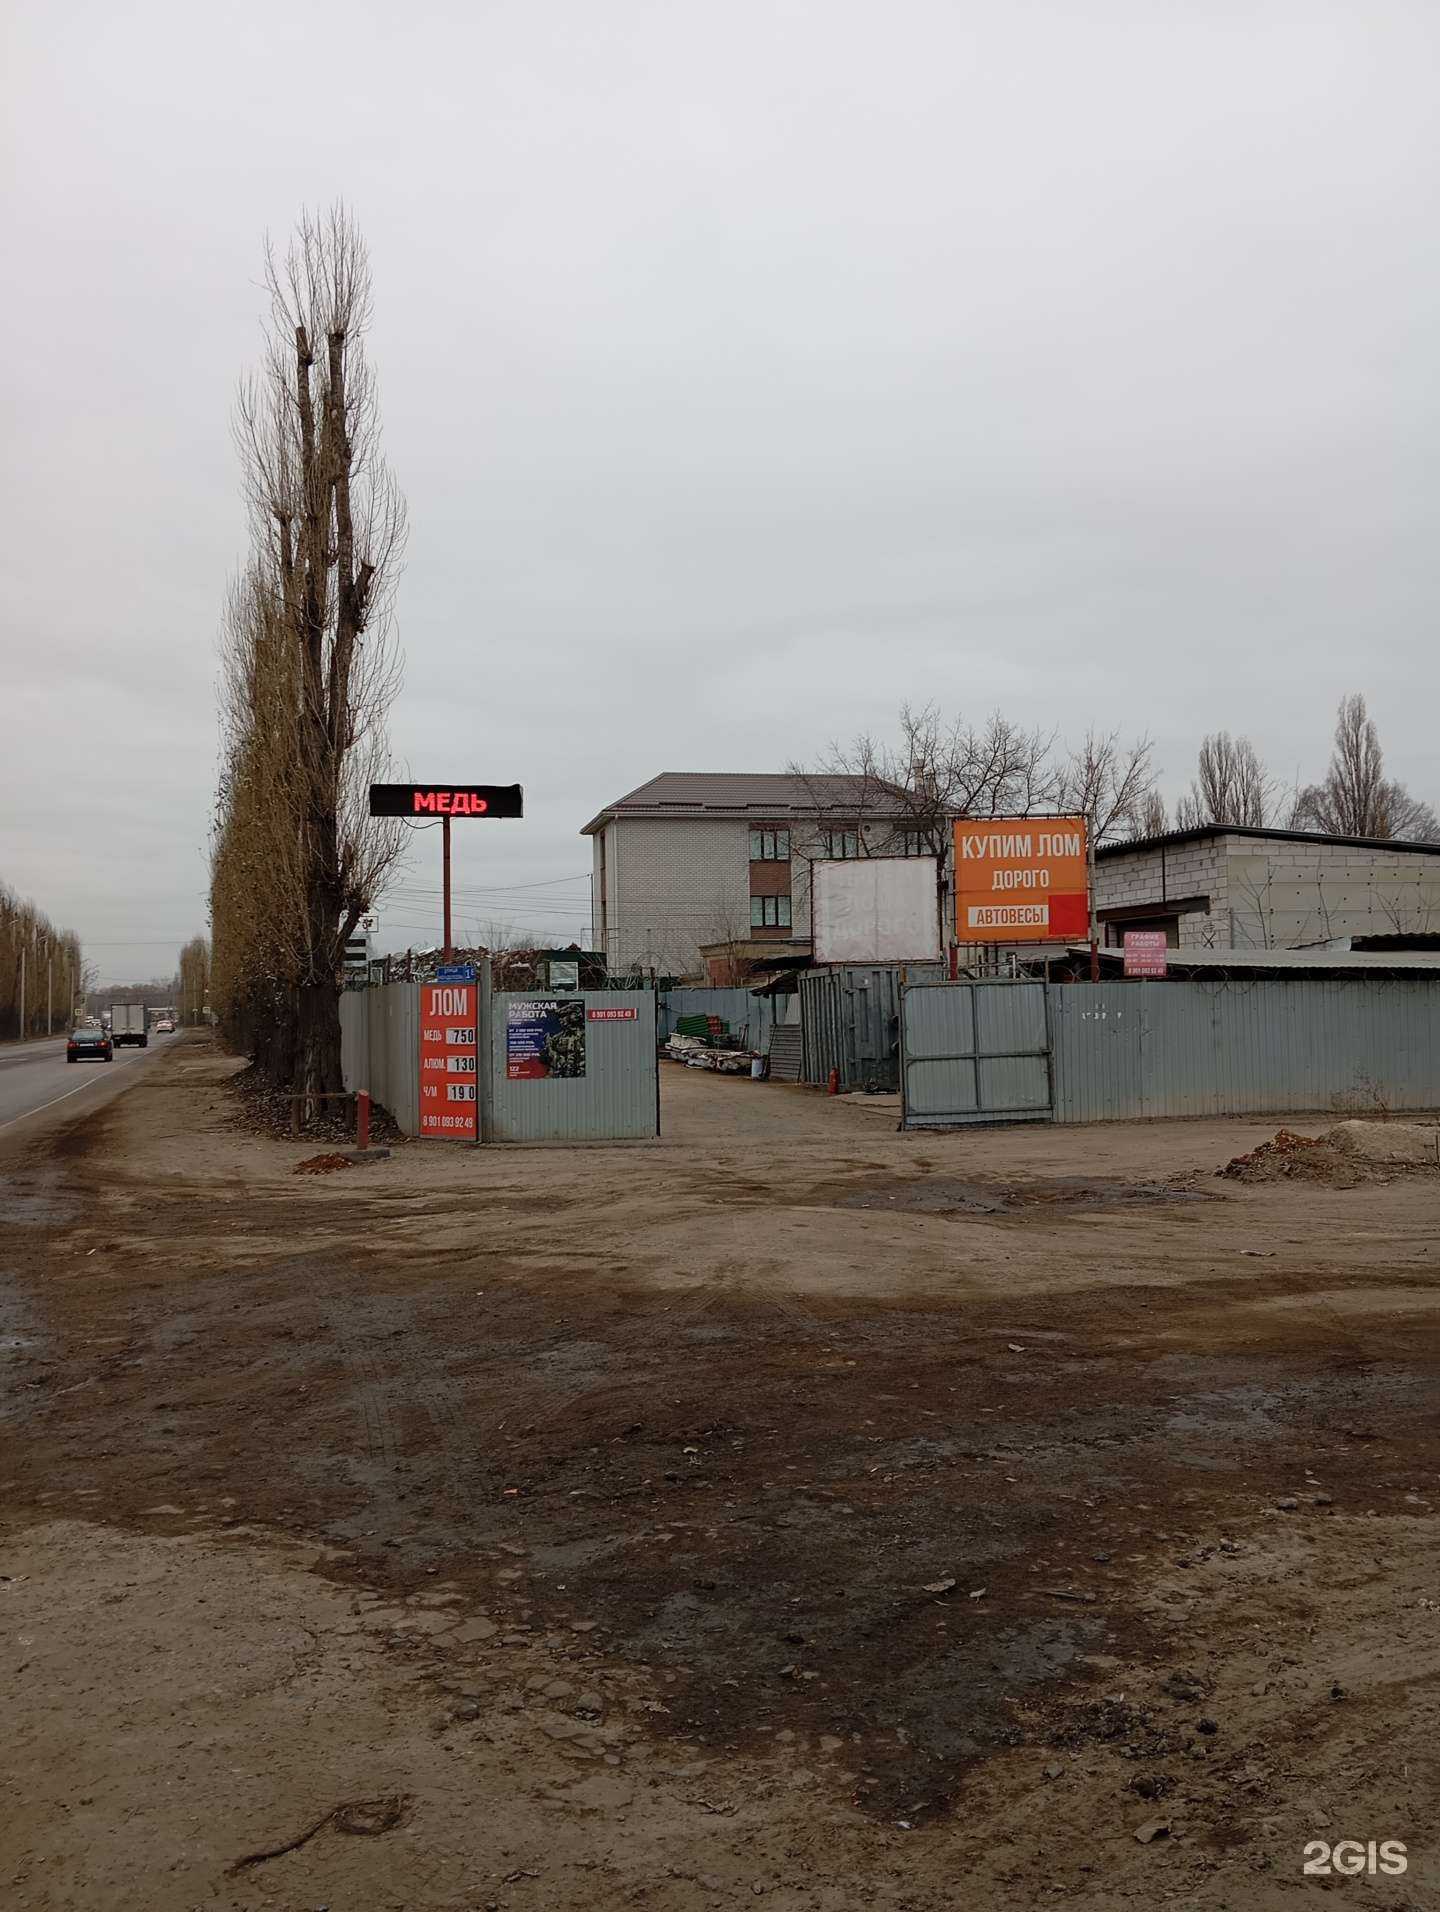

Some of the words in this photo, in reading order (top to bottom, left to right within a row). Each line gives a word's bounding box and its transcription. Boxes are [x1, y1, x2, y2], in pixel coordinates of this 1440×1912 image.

[414, 792, 487, 814] МЕДЬ
[962, 834, 1032, 858] КУПИМ
[1036, 833, 1080, 857] ЛОМ
[991, 869, 1050, 890] ДОРОГО
[976, 907, 1044, 924] АВТОВЕСЫ
[430, 988, 467, 1016] ЛОМ
[508, 1001, 558, 1010] МУЖСКАЯ
[508, 1010, 547, 1018] РАБОТА
[424, 1029, 442, 1042] МЕДЬ
[454, 1029, 474, 1043] 750
[455, 1057, 475, 1071] 130
[423, 1085, 437, 1097] Ч/М
